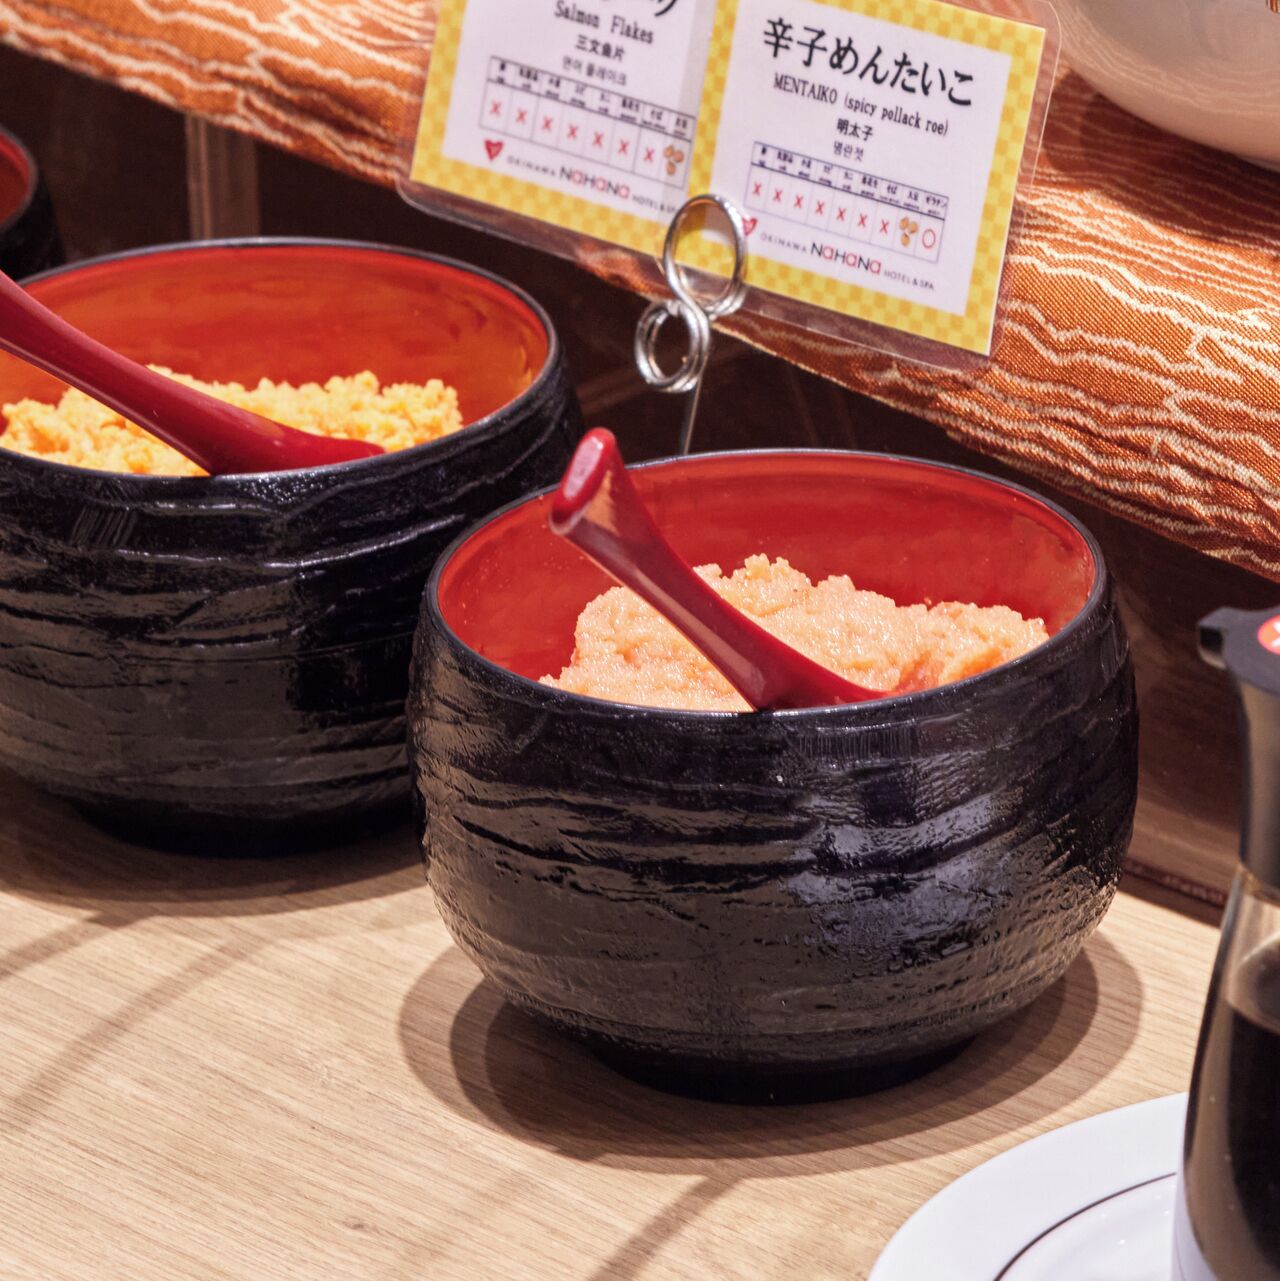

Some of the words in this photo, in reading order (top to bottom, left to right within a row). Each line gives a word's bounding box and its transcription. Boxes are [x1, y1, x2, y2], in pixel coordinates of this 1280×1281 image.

[610, 14, 654, 45] Flakes
[763, 16, 974, 107] 辛子めんたいこ
[773, 72, 838, 105] MENTAIKO
[843, 94, 878, 118] (spicy
[880, 105, 922, 130] pollack
[924, 119, 949, 137] roe)
[836, 117, 873, 142] 明太子
[883, 269, 911, 285] HOTEL
[920, 280, 934, 290] SPA
